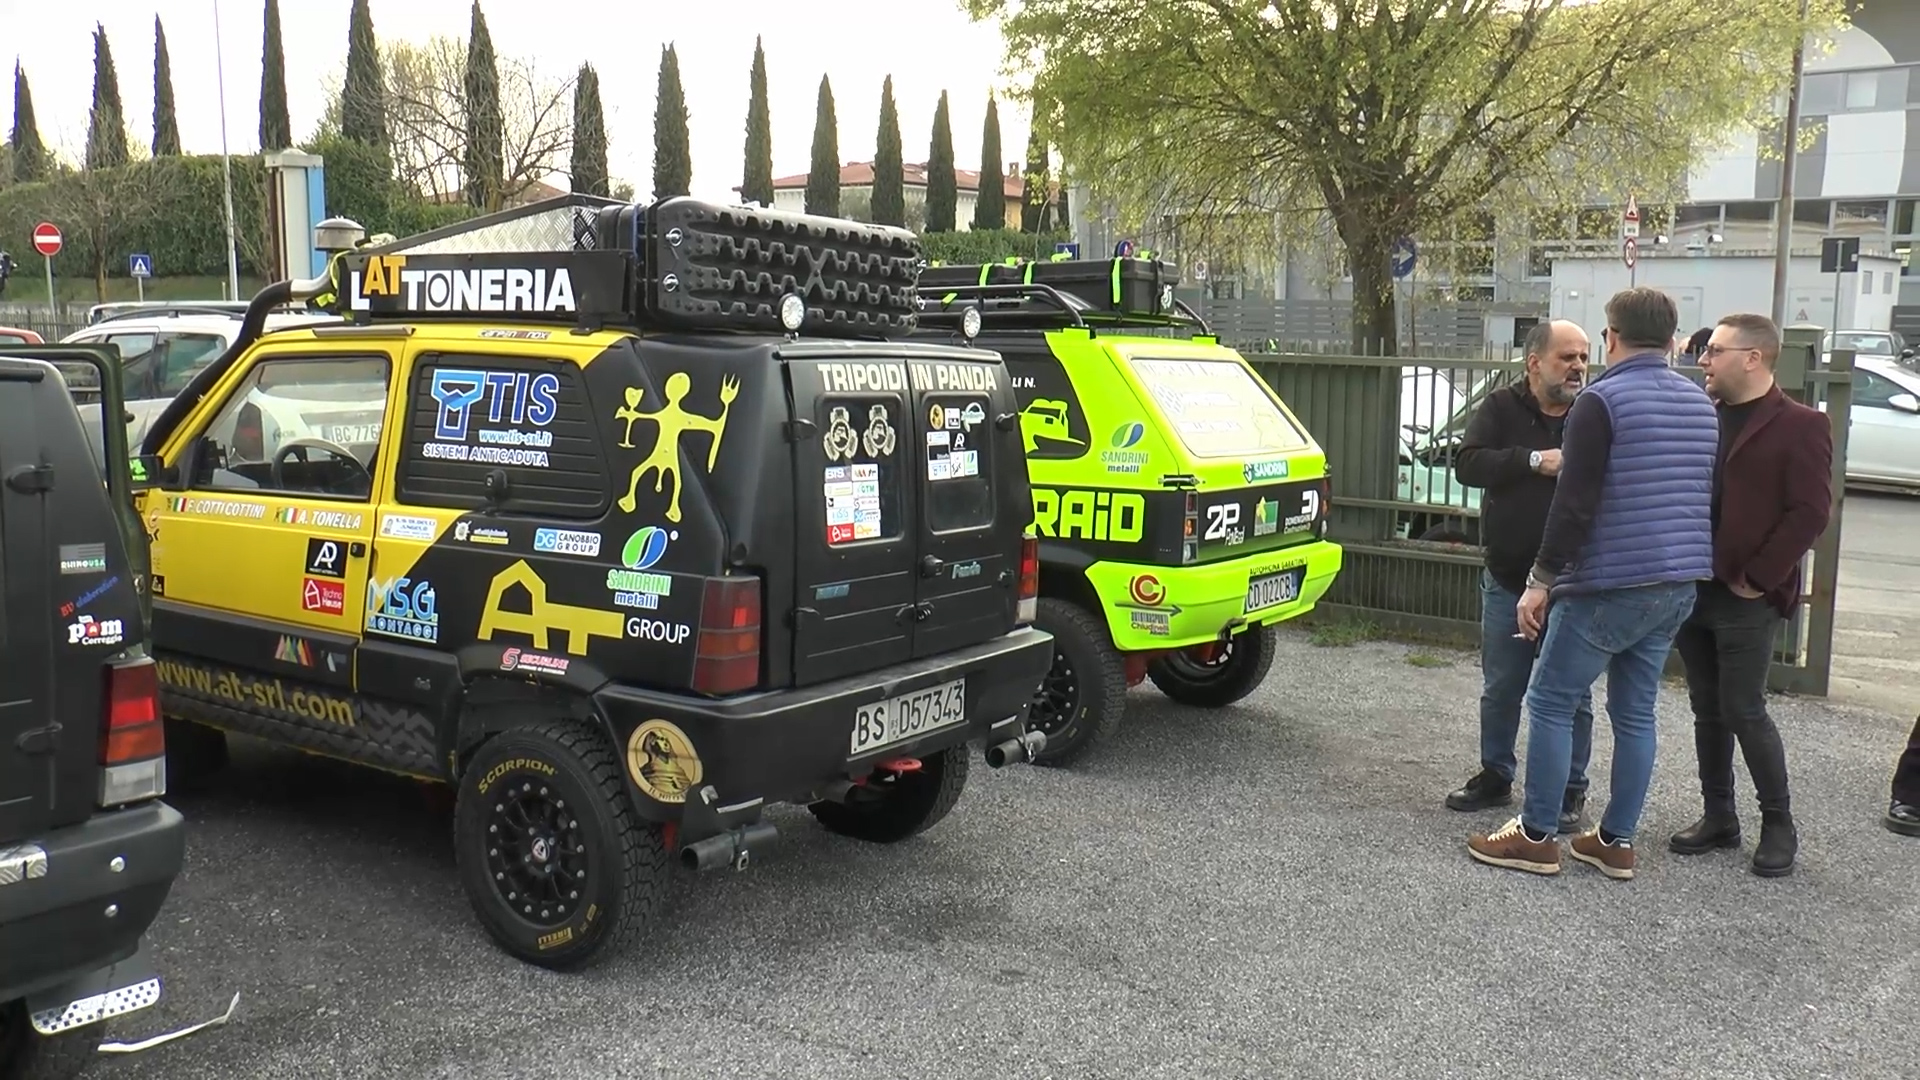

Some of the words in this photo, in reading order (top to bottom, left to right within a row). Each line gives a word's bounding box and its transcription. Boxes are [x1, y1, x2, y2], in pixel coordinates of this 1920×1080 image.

[350, 255, 576, 312] LATTONERIA
[817, 364, 908, 392] TRIPOIDI
[911, 364, 934, 391] IN
[936, 365, 997, 391] PANDA
[486, 372, 560, 426] TIS
[479, 429, 553, 447] www.tis-srl.it
[423, 443, 469, 460] SISTEMI
[469, 446, 549, 468] ANTICADUTA
[1101, 451, 1149, 464] SANDRINI
[1107, 464, 1140, 474] metalli
[297, 512, 308, 524] A.
[311, 510, 362, 529] TONELLA
[557, 541, 594, 553] GROUP
[558, 532, 599, 545] CANOBBIO
[321, 587, 343, 601] Techno
[607, 569, 672, 597] SANDRINI
[1261, 575, 1292, 604] 022CB
[321, 596, 343, 610] House
[614, 591, 659, 610] metalli
[627, 617, 691, 645] GROUP
[155, 660, 355, 728] www.at-srl.com
[856, 705, 885, 747] BS
[899, 684, 963, 734] D57343
[478, 758, 556, 794] SCORPION
